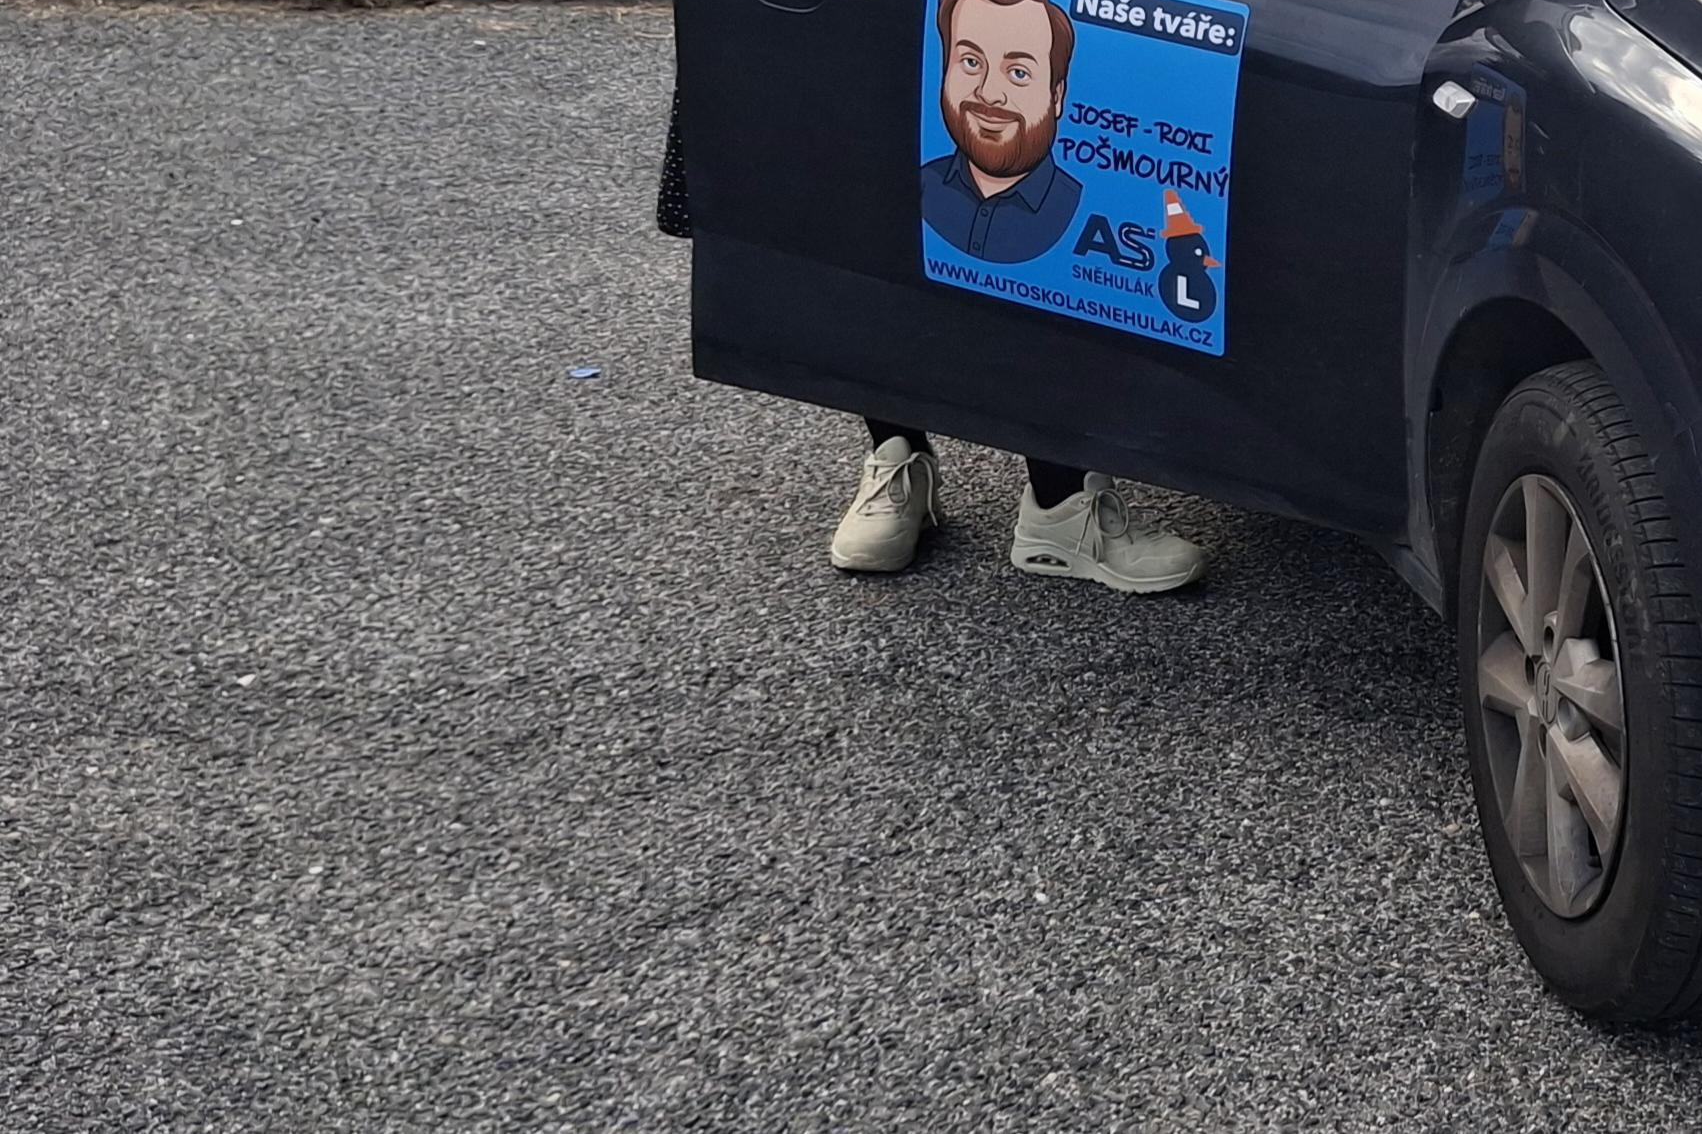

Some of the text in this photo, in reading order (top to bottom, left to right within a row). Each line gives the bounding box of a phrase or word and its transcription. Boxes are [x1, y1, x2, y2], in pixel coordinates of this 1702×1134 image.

[1153, 7, 1236, 47] tváře:
[1069, 102, 1139, 138] JOSEF
[1058, 135, 1229, 197] POŠMOURNÝ
[1073, 213, 1156, 271] AS
[1072, 264, 1154, 298] SNĚHULÁK
[1176, 275, 1200, 310] L
[927, 258, 1213, 347] WWW.AUTOSKOLASNEHULAK.CZ
